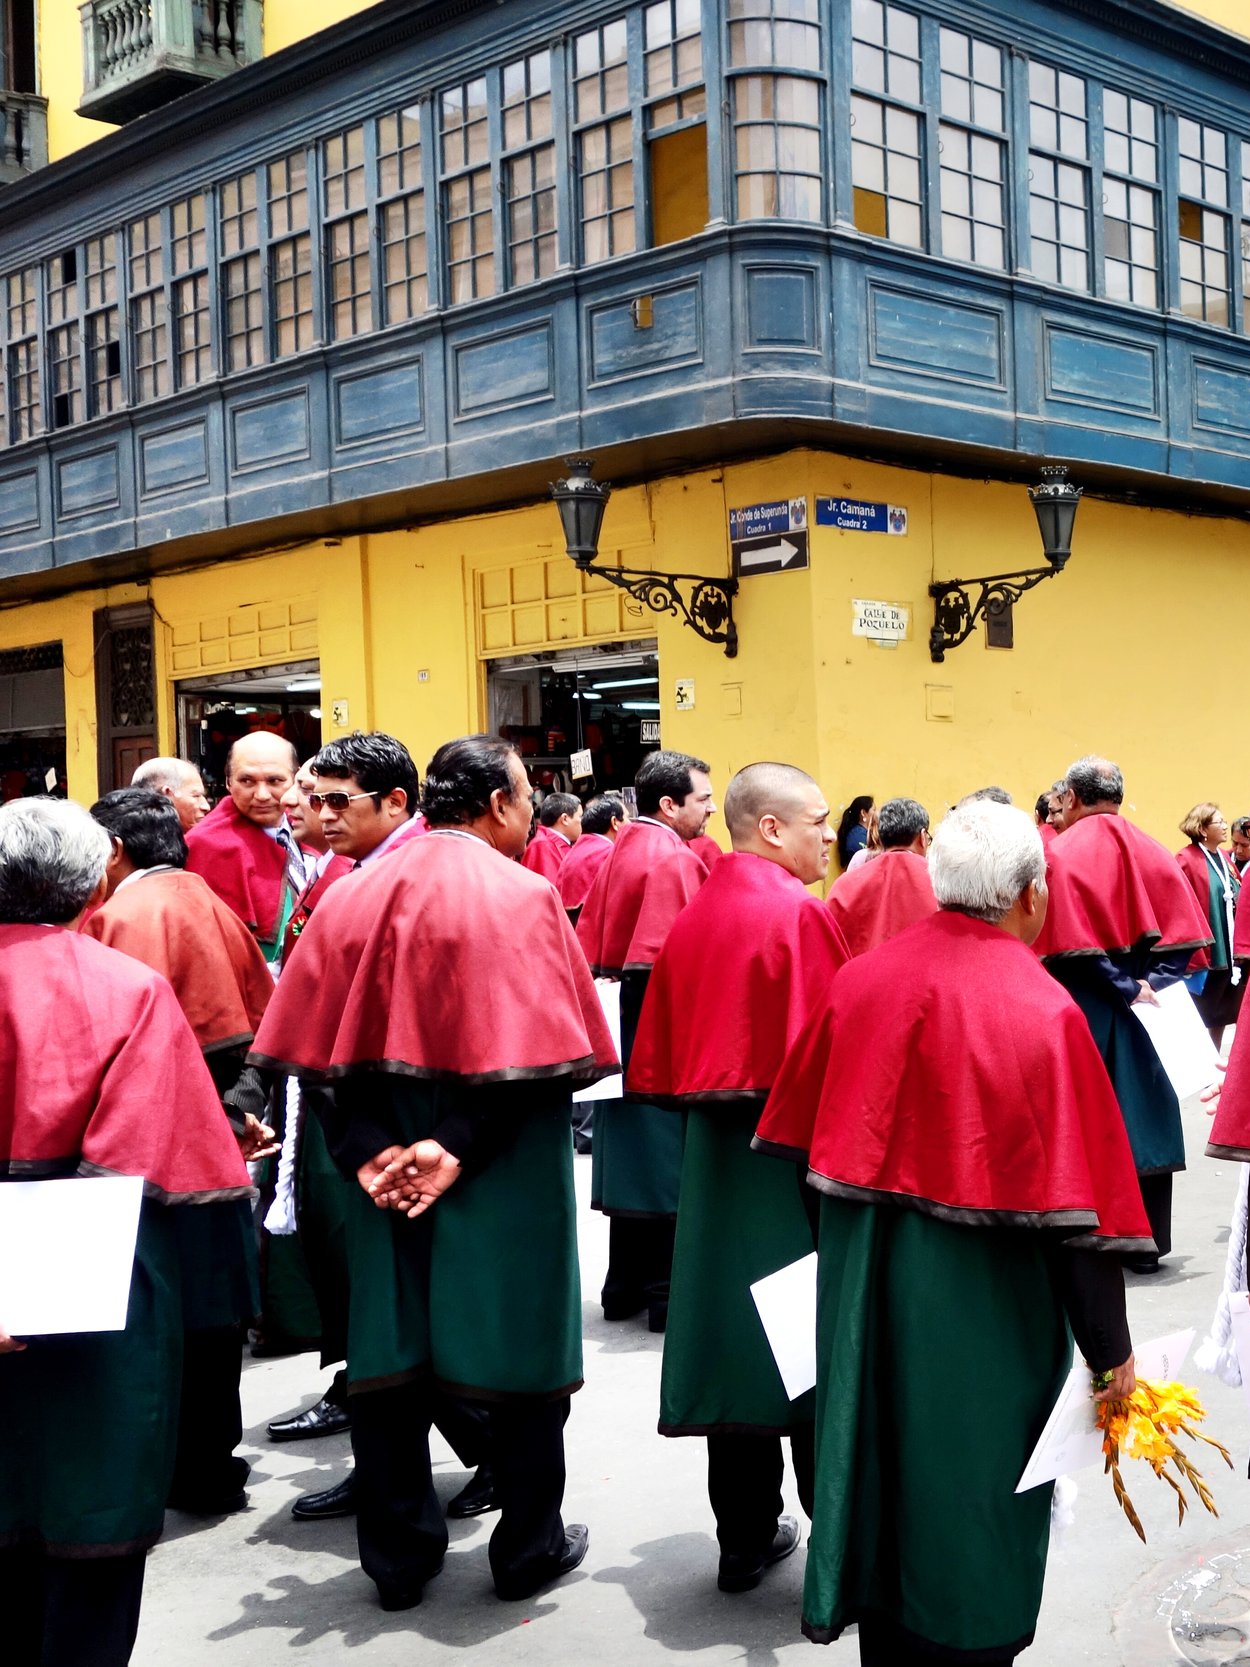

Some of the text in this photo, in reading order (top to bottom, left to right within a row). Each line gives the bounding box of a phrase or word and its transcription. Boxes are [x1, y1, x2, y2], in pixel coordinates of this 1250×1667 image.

[737, 509, 753, 522] Conde
[754, 508, 760, 520] de
[760, 503, 788, 520] Superunda
[827, 499, 876, 517] Jr. Camaná
[746, 523, 766, 535] Cuadra
[837, 516, 868, 530] Cuadra 2
[891, 610, 900, 620] DE
[859, 618, 905, 630] POZUELO
